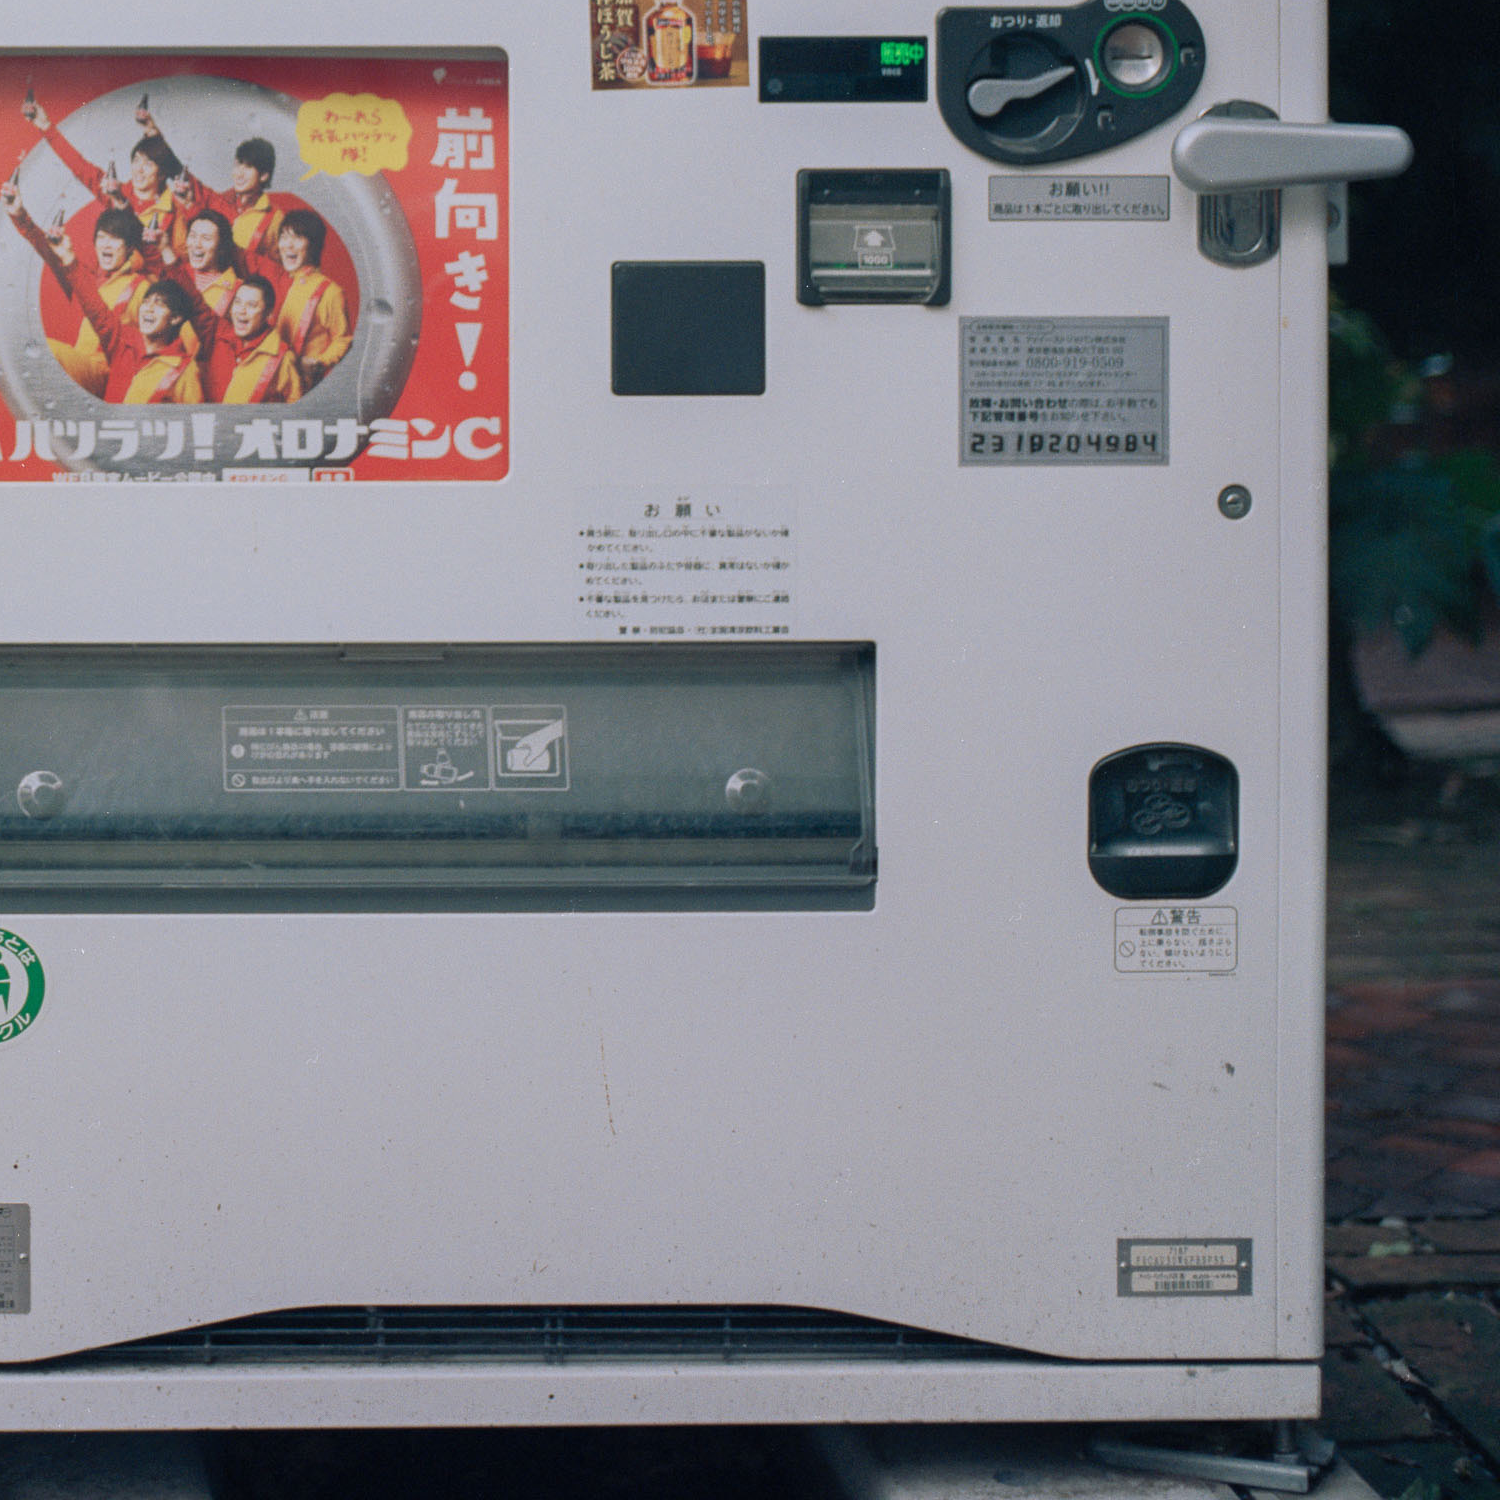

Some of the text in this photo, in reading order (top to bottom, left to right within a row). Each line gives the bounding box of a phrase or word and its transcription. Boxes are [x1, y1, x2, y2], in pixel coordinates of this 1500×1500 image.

[990, 14, 1062, 28] おつり・返却
[235, 416, 503, 460] オロナミンC
